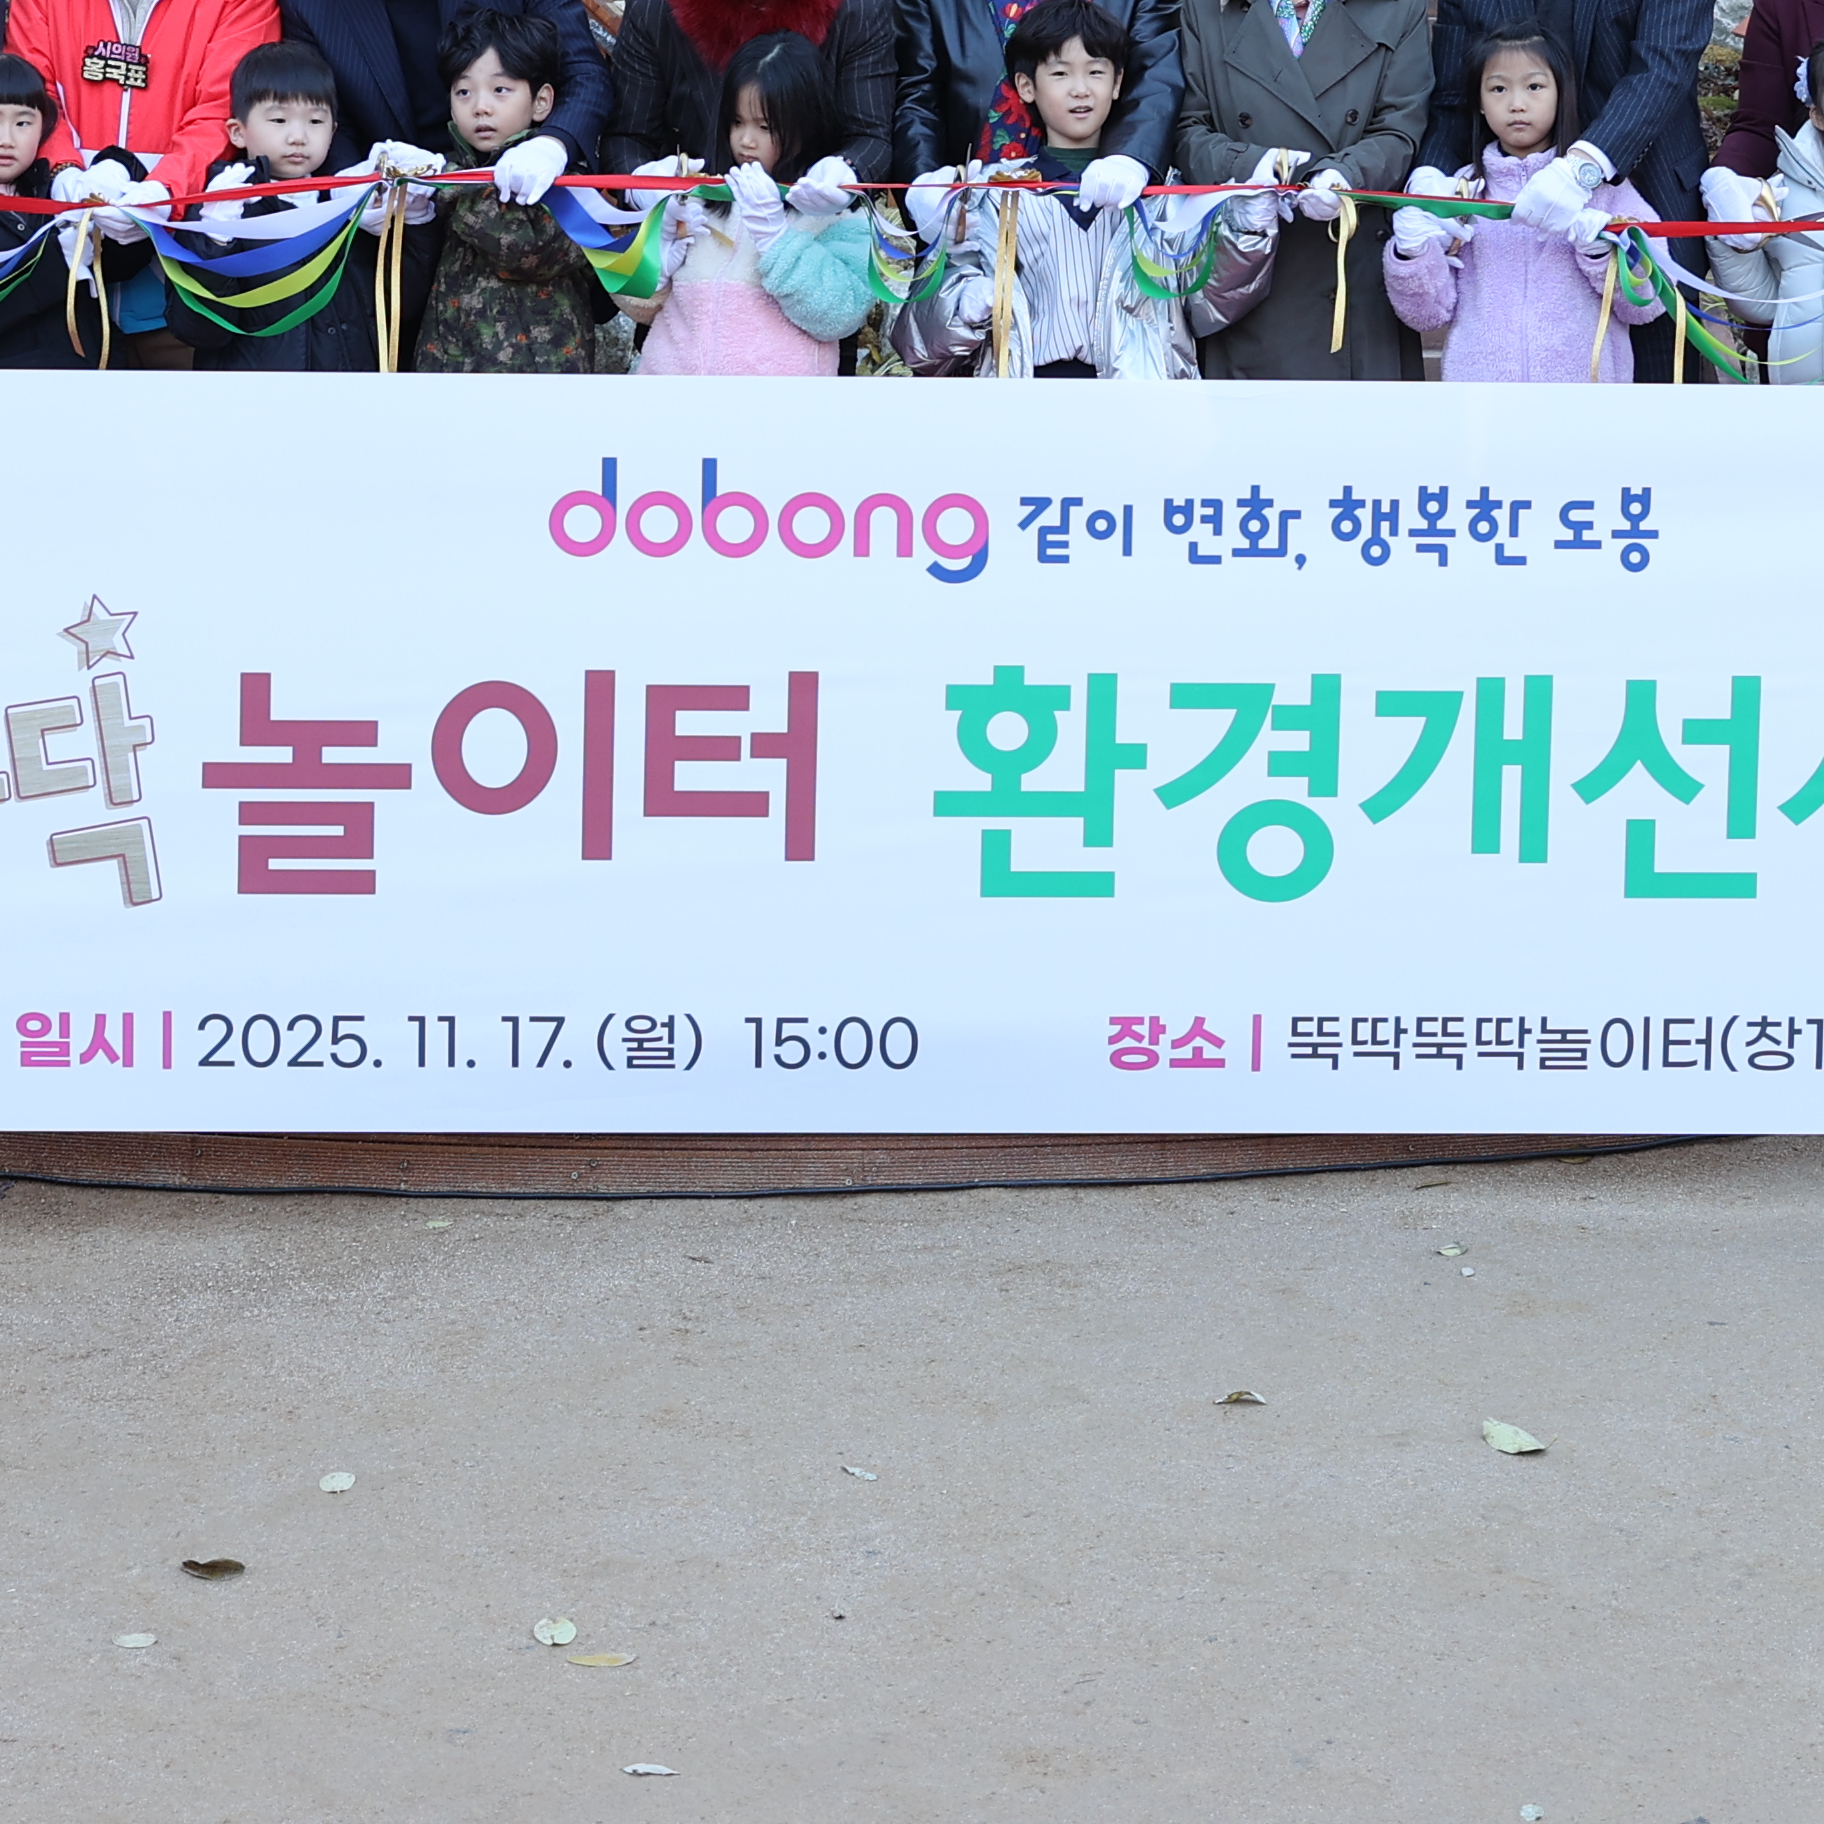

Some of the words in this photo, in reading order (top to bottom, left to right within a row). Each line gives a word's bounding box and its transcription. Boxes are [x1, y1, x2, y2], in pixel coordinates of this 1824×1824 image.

[82, 57, 147, 87] 홍국표
[549, 457, 990, 585] dobong
[1018, 497, 1135, 566] 같이
[1163, 485, 1308, 572] 변화,
[1329, 485, 1534, 569] 행복한
[1554, 487, 1661, 574] 도봉
[16, 1012, 135, 1069] 일시
[198, 1014, 384, 1070] 2025.
[408, 1016, 478, 1070] 11.
[501, 1016, 574, 1071] 17.
[597, 1013, 704, 1073] (월)
[745, 1016, 920, 1072] 15:00
[1108, 1016, 1227, 1073] 장소
